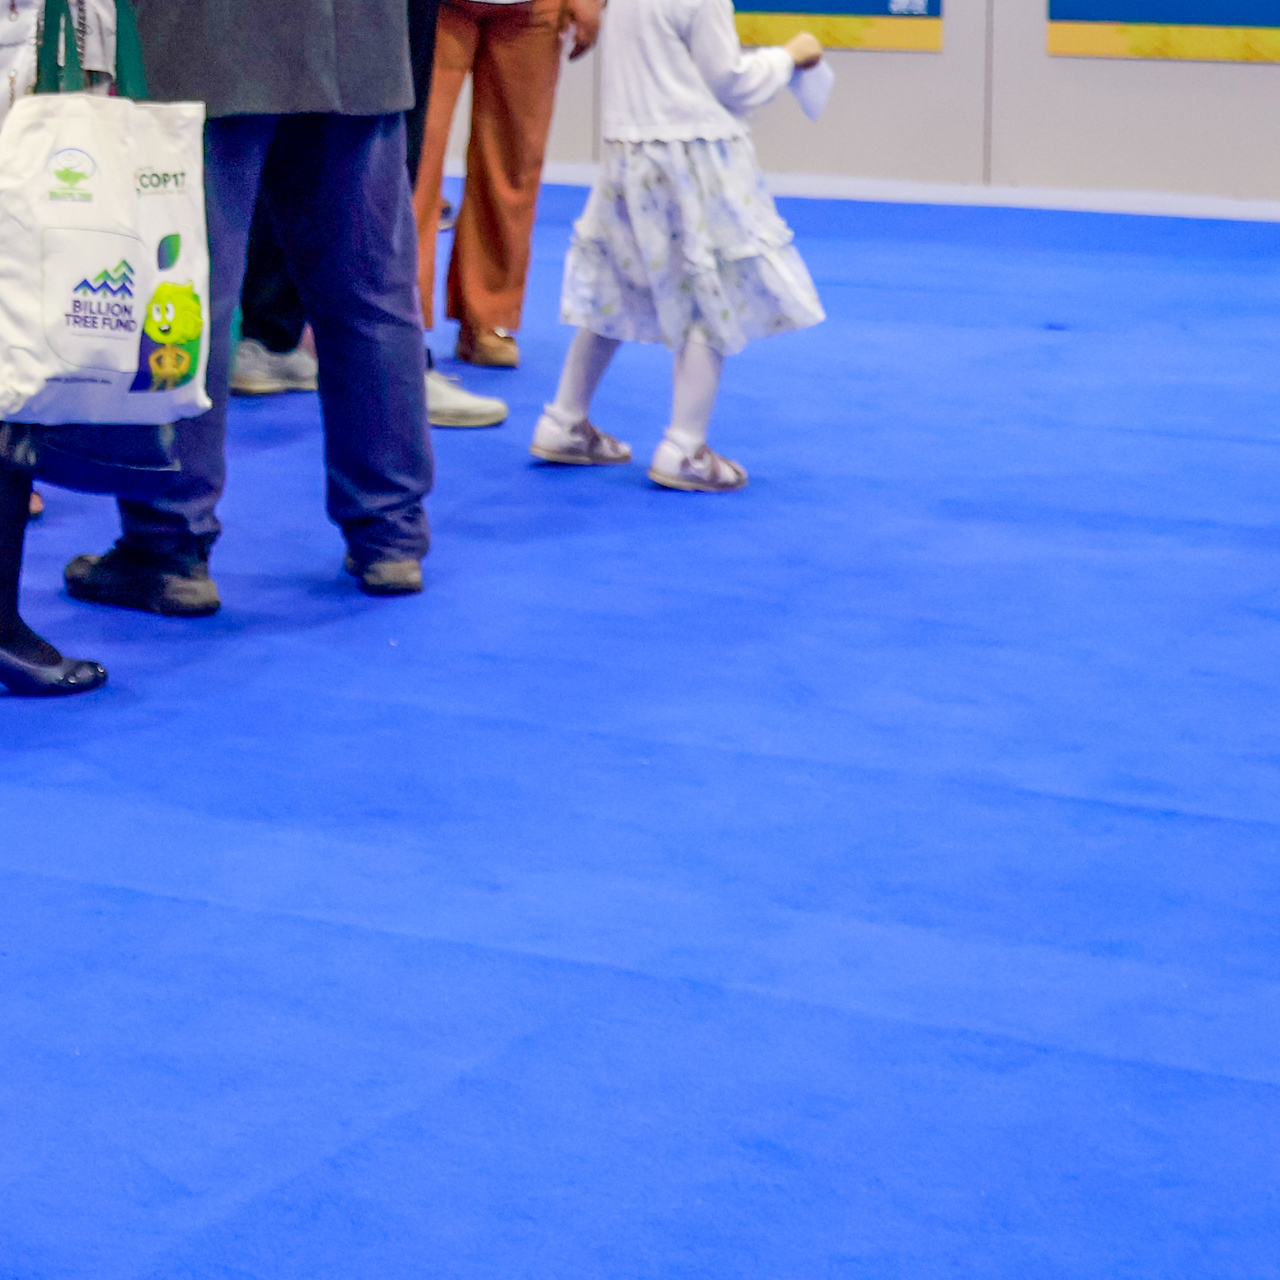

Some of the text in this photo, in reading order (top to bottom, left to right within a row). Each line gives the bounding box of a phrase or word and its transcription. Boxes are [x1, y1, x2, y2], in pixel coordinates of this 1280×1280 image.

[73, 299, 133, 318] BILLION
[65, 314, 138, 332] TREE FUND
